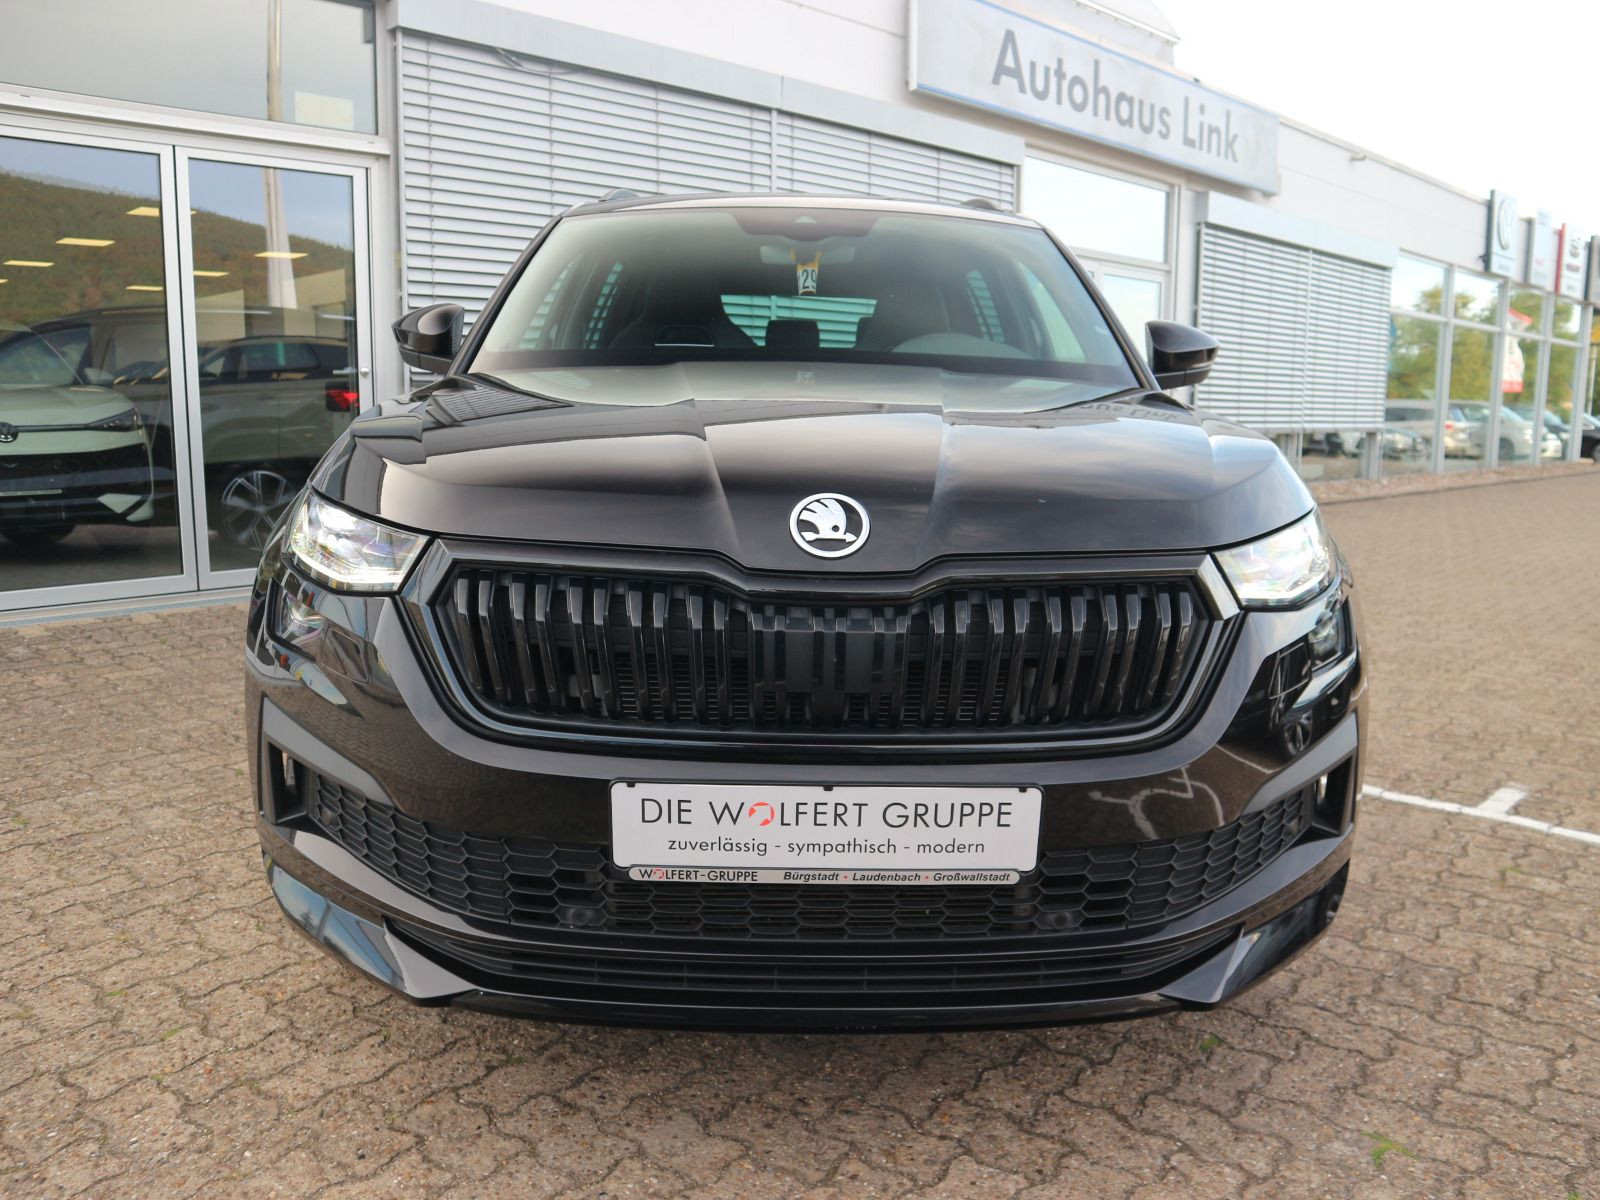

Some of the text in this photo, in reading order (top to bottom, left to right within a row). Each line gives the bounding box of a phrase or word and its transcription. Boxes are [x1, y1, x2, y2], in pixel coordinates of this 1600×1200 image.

[991, 28, 1238, 163] Autohaus Link
[641, 798, 1013, 828] DIE WOLFERT GRUPPE
[668, 836, 768, 856] zuverlässig
[787, 837, 897, 857] sympathisch
[917, 838, 985, 854] modern
[783, 871, 840, 883] Bürgstadt
[852, 872, 921, 882] Laudenbach
[933, 872, 1011, 882] Großwallstadt
